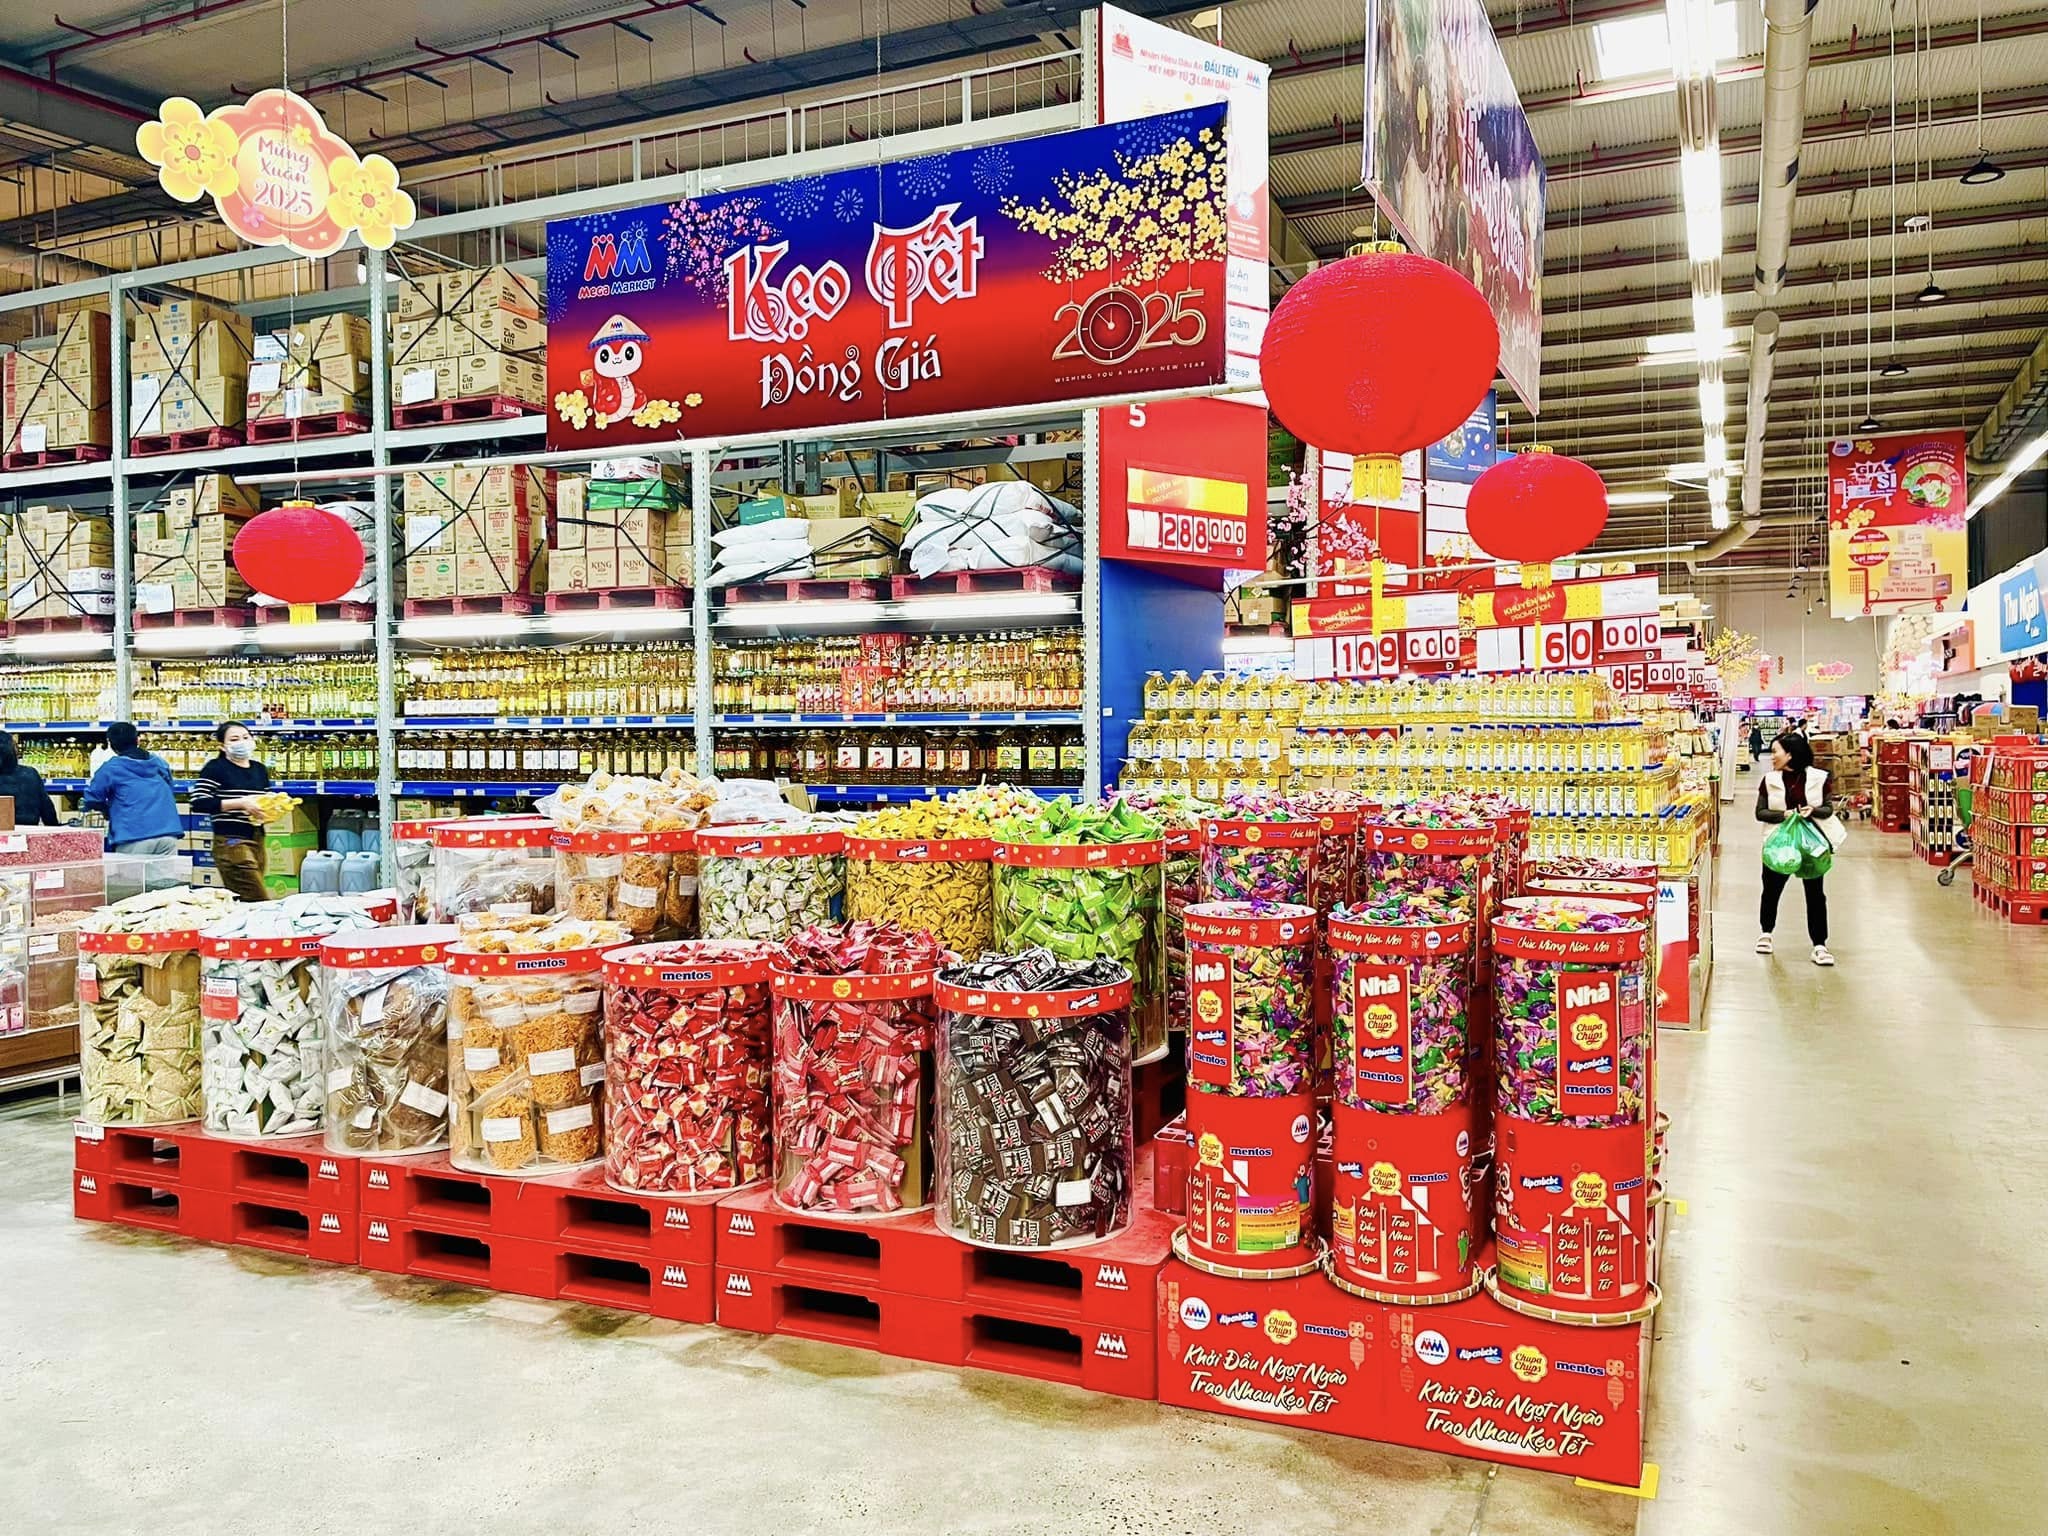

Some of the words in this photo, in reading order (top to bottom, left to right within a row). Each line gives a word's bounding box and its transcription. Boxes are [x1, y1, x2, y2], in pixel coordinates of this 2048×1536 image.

[1188, 74, 1196, 86] 3
[255, 181, 313, 215] 2025
[723, 240, 851, 343] Kẹo
[865, 202, 984, 329] Tết
[758, 344, 862, 408] Đồng
[875, 335, 942, 391] Giá
[1054, 374, 1093, 383] WISHING
[1097, 370, 1113, 378] YOU
[1127, 367, 1155, 375] HAPPY
[1184, 361, 1205, 369] YEAR
[1128, 403, 1147, 428] 5
[2004, 592, 2018, 626] Thu
[2020, 582, 2039, 633] Ngân
[516, 957, 567, 970] mentos
[661, 970, 712, 981] mentos
[1194, 962, 1225, 983] Nhà
[1360, 974, 1401, 998] Nhà
[1200, 997, 1218, 1007] Chupa
[1565, 982, 1611, 1009] Nhà
[1200, 1006, 1218, 1017] Chups
[1368, 1012, 1392, 1022] Chupa
[1368, 1020, 1392, 1033] Chups
[1576, 1022, 1603, 1034] Chupa
[1576, 1031, 1603, 1044] Chups
[1194, 1052, 1227, 1066] mentos
[1360, 1070, 1403, 1083] mentos
[1565, 1085, 1612, 1095] mentos
[1201, 1140, 1220, 1150] Chupa
[1230, 1147, 1272, 1156] mentos
[1200, 1148, 1219, 1160] Chups
[1372, 1170, 1396, 1180] Chupa
[1408, 1172, 1449, 1182] mentos
[1372, 1178, 1396, 1190] Chups
[1576, 1181, 1603, 1190] Chupa
[1575, 1189, 1602, 1202] Chups
[1596, 1229, 1616, 1242] Trao
[1593, 1246, 1618, 1256] Nhau
[1268, 1316, 1293, 1328] Chupa
[1267, 1325, 1292, 1338] Chups
[1304, 1324, 1348, 1338] mentos
[1515, 1353, 1542, 1365] Chupa
[1183, 1344, 1222, 1366] Khởi
[1224, 1349, 1260, 1372] Đầu
[1260, 1356, 1305, 1383] Ngọt
[1302, 1363, 1348, 1389] Ngào
[1514, 1361, 1542, 1376] Chups
[1556, 1360, 1606, 1376] mentos
[1190, 1370, 1223, 1396] Trao
[1225, 1378, 1273, 1404] Nhau
[1273, 1384, 1305, 1412] Kẹo
[1307, 1390, 1338, 1414] Tết
[1418, 1378, 1462, 1404] Khởi
[1463, 1386, 1504, 1410] Đầu
[1506, 1394, 1558, 1423] Ngọt
[1553, 1401, 1604, 1430] Ngào
[1425, 1407, 1464, 1436] Trao
[1466, 1417, 1520, 1445] Nhau
[1520, 1424, 1555, 1454] Kẹo
[1558, 1430, 1594, 1456] Tết
